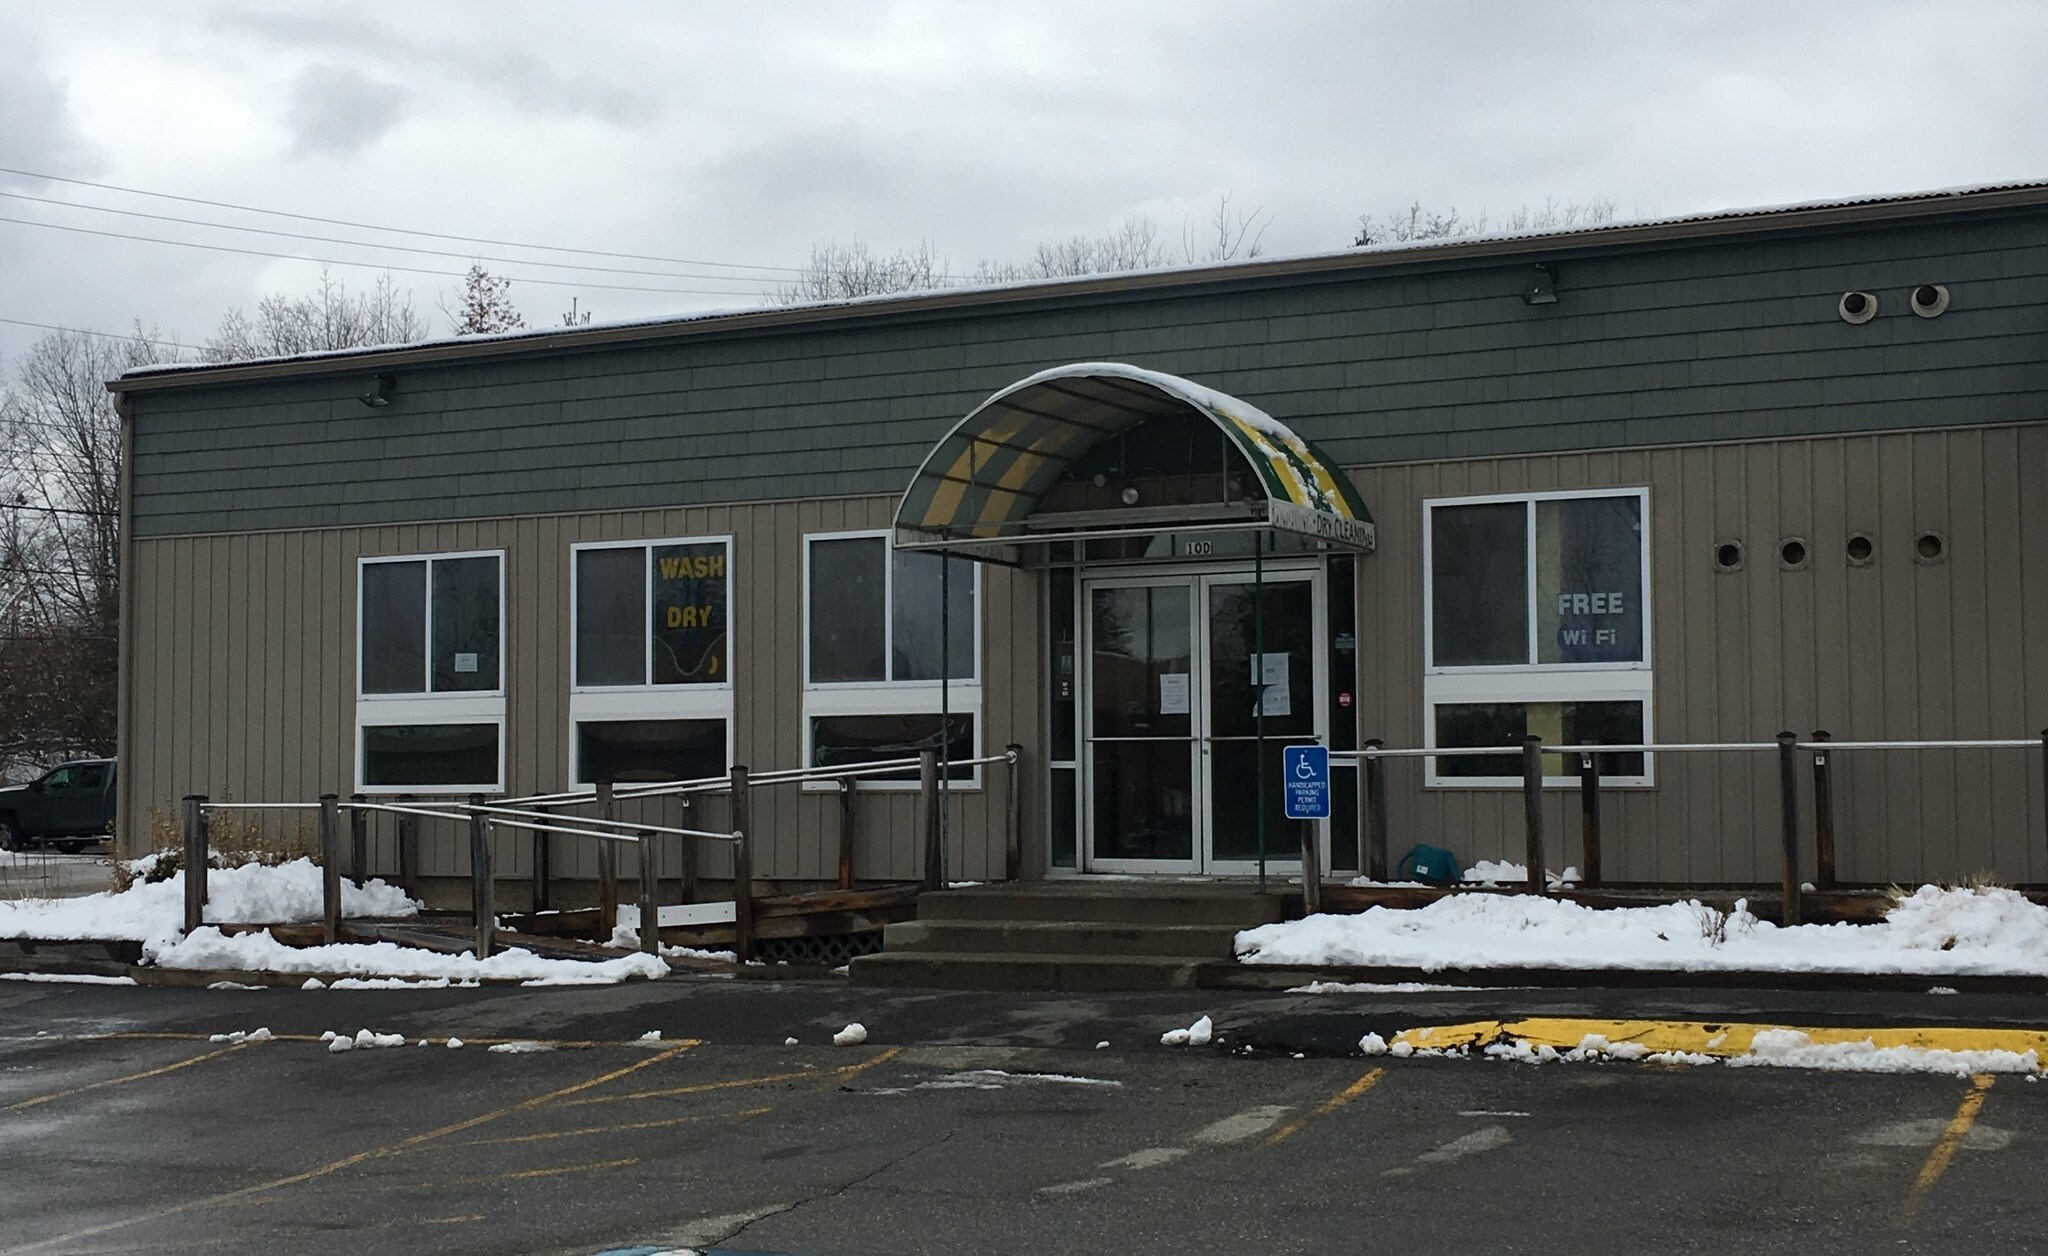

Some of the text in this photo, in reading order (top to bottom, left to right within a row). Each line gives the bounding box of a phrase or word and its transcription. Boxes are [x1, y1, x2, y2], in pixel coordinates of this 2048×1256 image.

[659, 555, 724, 579] WASH
[1558, 592, 1624, 615] FREE
[667, 605, 713, 628] DRY
[1563, 628, 1616, 646] Wi Fi
[1288, 781, 1326, 789] HANDICAPPED
[1295, 789, 1319, 797] PARKING
[1297, 796, 1317, 804] PERMIT
[1294, 804, 1321, 812] REQUIRED
